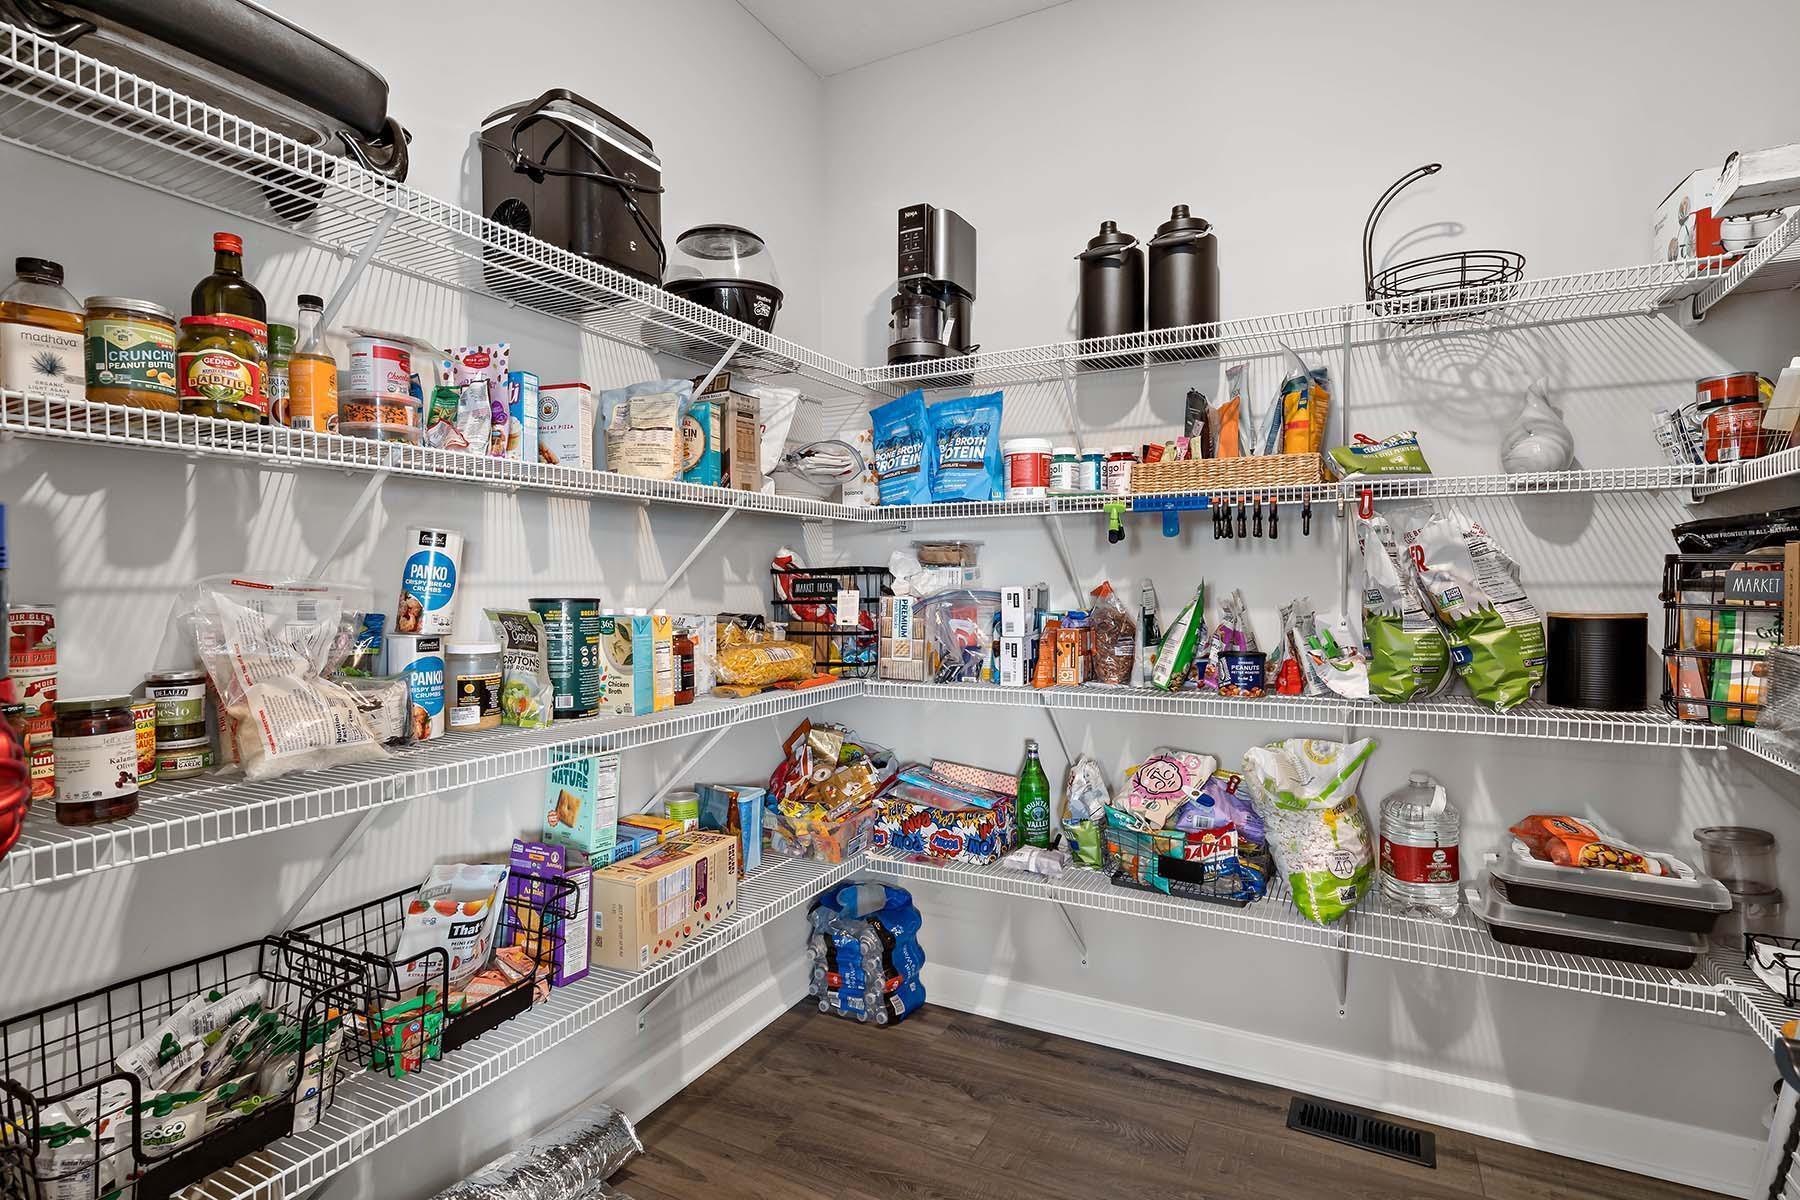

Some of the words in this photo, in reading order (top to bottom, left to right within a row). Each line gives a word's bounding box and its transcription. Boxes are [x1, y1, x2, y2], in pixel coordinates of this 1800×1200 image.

[108, 350, 174, 363] CRUNCHY
[203, 357, 239, 368] GEDNEY
[108, 361, 145, 369] PEANUT
[955, 436, 988, 447] BROTH
[1108, 463, 1125, 473] goli
[1719, 530, 1748, 538] FRONTIER
[1755, 525, 1799, 535] ALL-NATURAL
[410, 563, 448, 581] PANKO
[412, 585, 442, 593] CRUMBS
[1732, 577, 1781, 593] MARKET
[601, 620, 614, 629] 365
[900, 598, 909, 638] PREMIUM
[503, 620, 526, 632] Olive
[511, 629, 538, 644] Garden
[410, 670, 443, 686] PANKO
[608, 680, 630, 688] Chicken
[335, 713, 343, 744] Nutrition
[551, 769, 589, 789] NATURE
[1027, 820, 1049, 828] VALLEY
[891, 834, 924, 854] POW
[1334, 859, 1354, 875] 40
